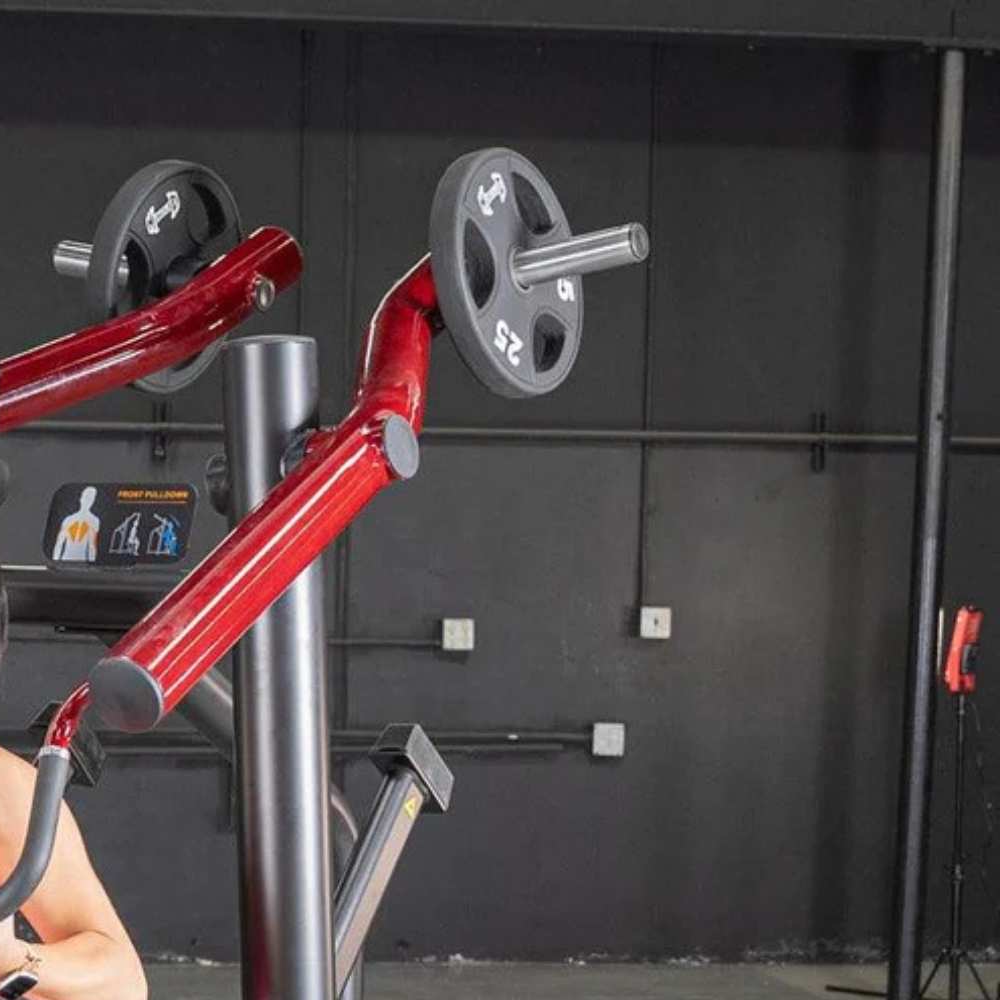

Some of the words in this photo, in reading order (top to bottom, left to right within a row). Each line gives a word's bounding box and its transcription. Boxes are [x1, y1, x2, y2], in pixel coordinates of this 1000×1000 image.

[494, 320, 523, 366] 25
[117, 489, 145, 499] FRONT
[145, 489, 189, 499] PULLDOWN
